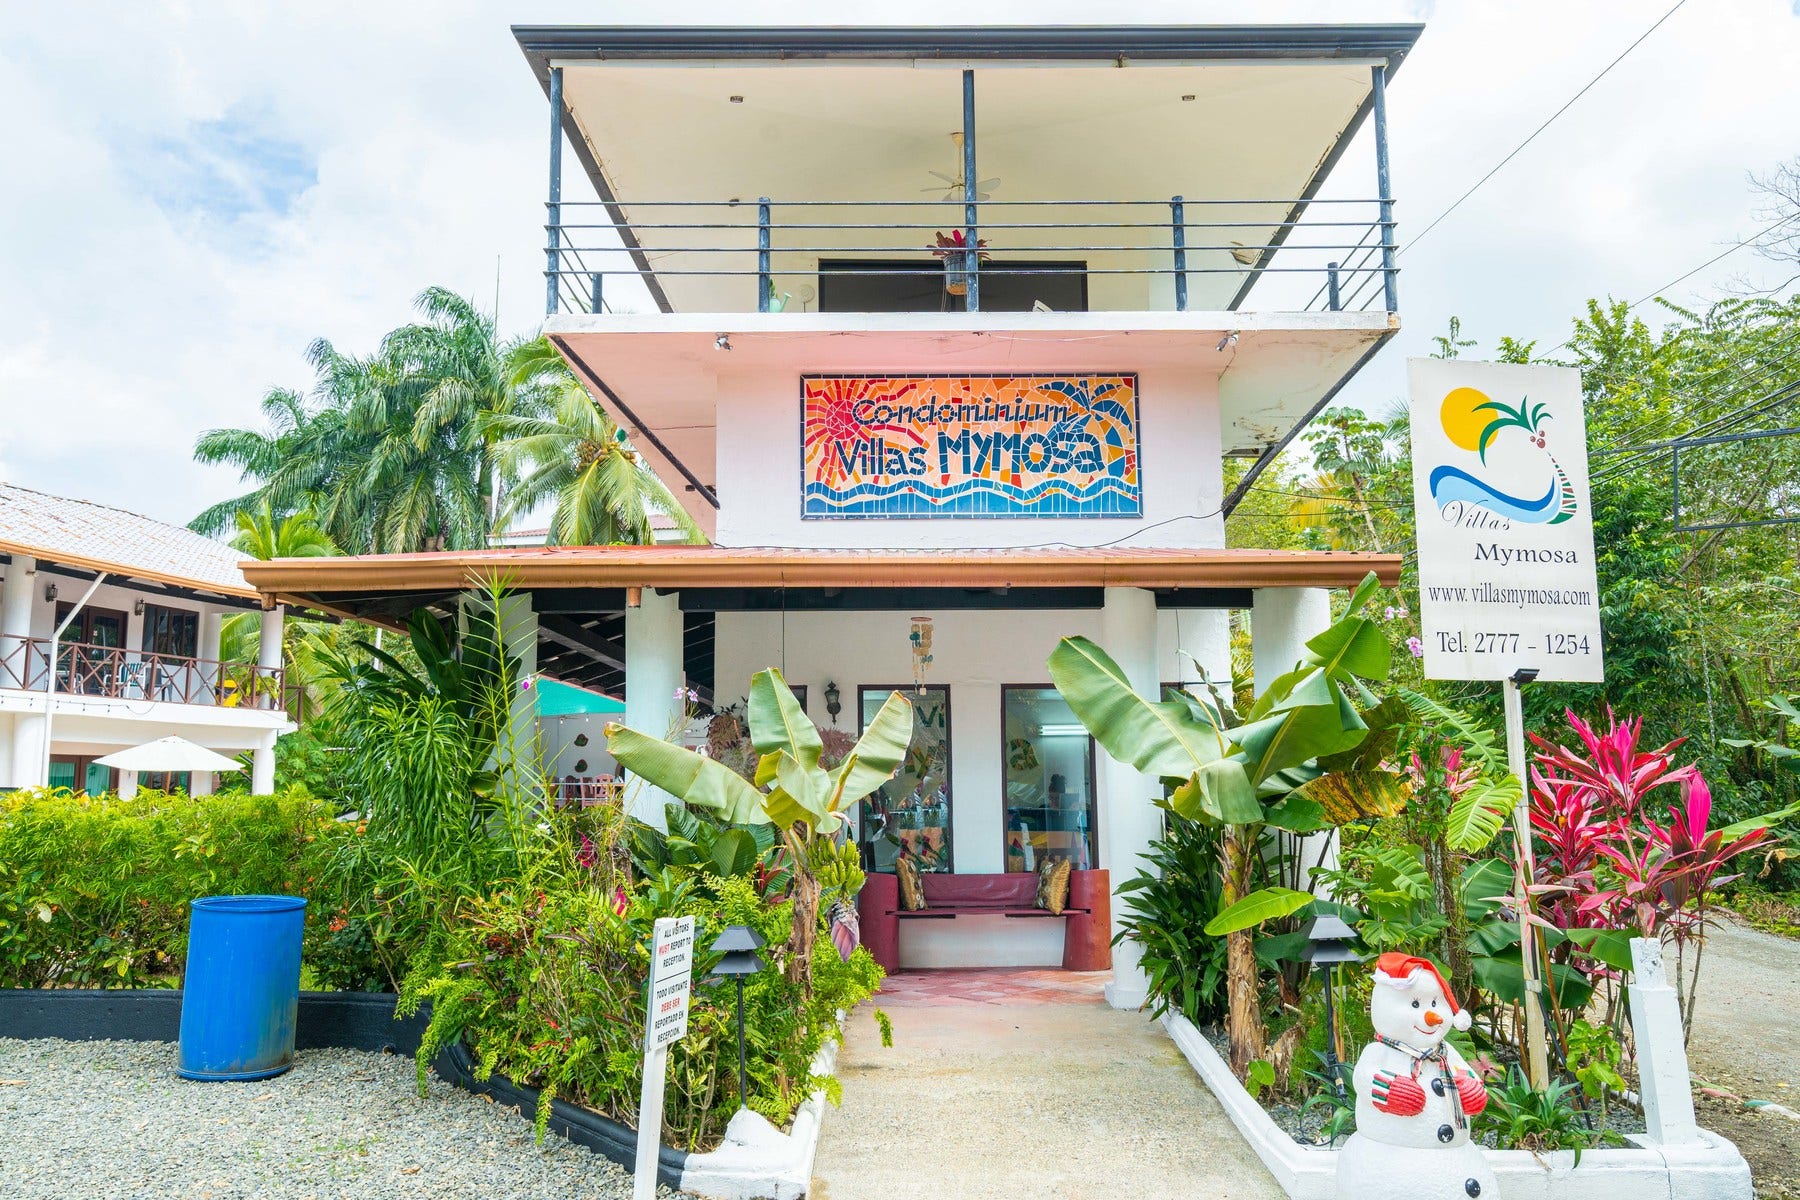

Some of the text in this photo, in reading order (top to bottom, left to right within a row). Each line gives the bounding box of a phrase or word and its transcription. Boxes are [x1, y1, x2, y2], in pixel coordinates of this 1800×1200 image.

[852, 395, 1078, 425] Condominium
[835, 437, 927, 476] Villas
[1441, 499, 1511, 531] Villas
[1474, 543, 1579, 566] Mymosa
[1474, 632, 1520, 654] 2777
[1545, 634, 1591, 655] 1254
[664, 922, 690, 938] ALL VISITORS
[658, 943, 670, 956] MUST
[670, 938, 686, 951] REPORT
[656, 979, 688, 999] TODO VISITANTE
[661, 997, 681, 1013] DEBE SER
[655, 1012, 678, 1030] REPORTADO
